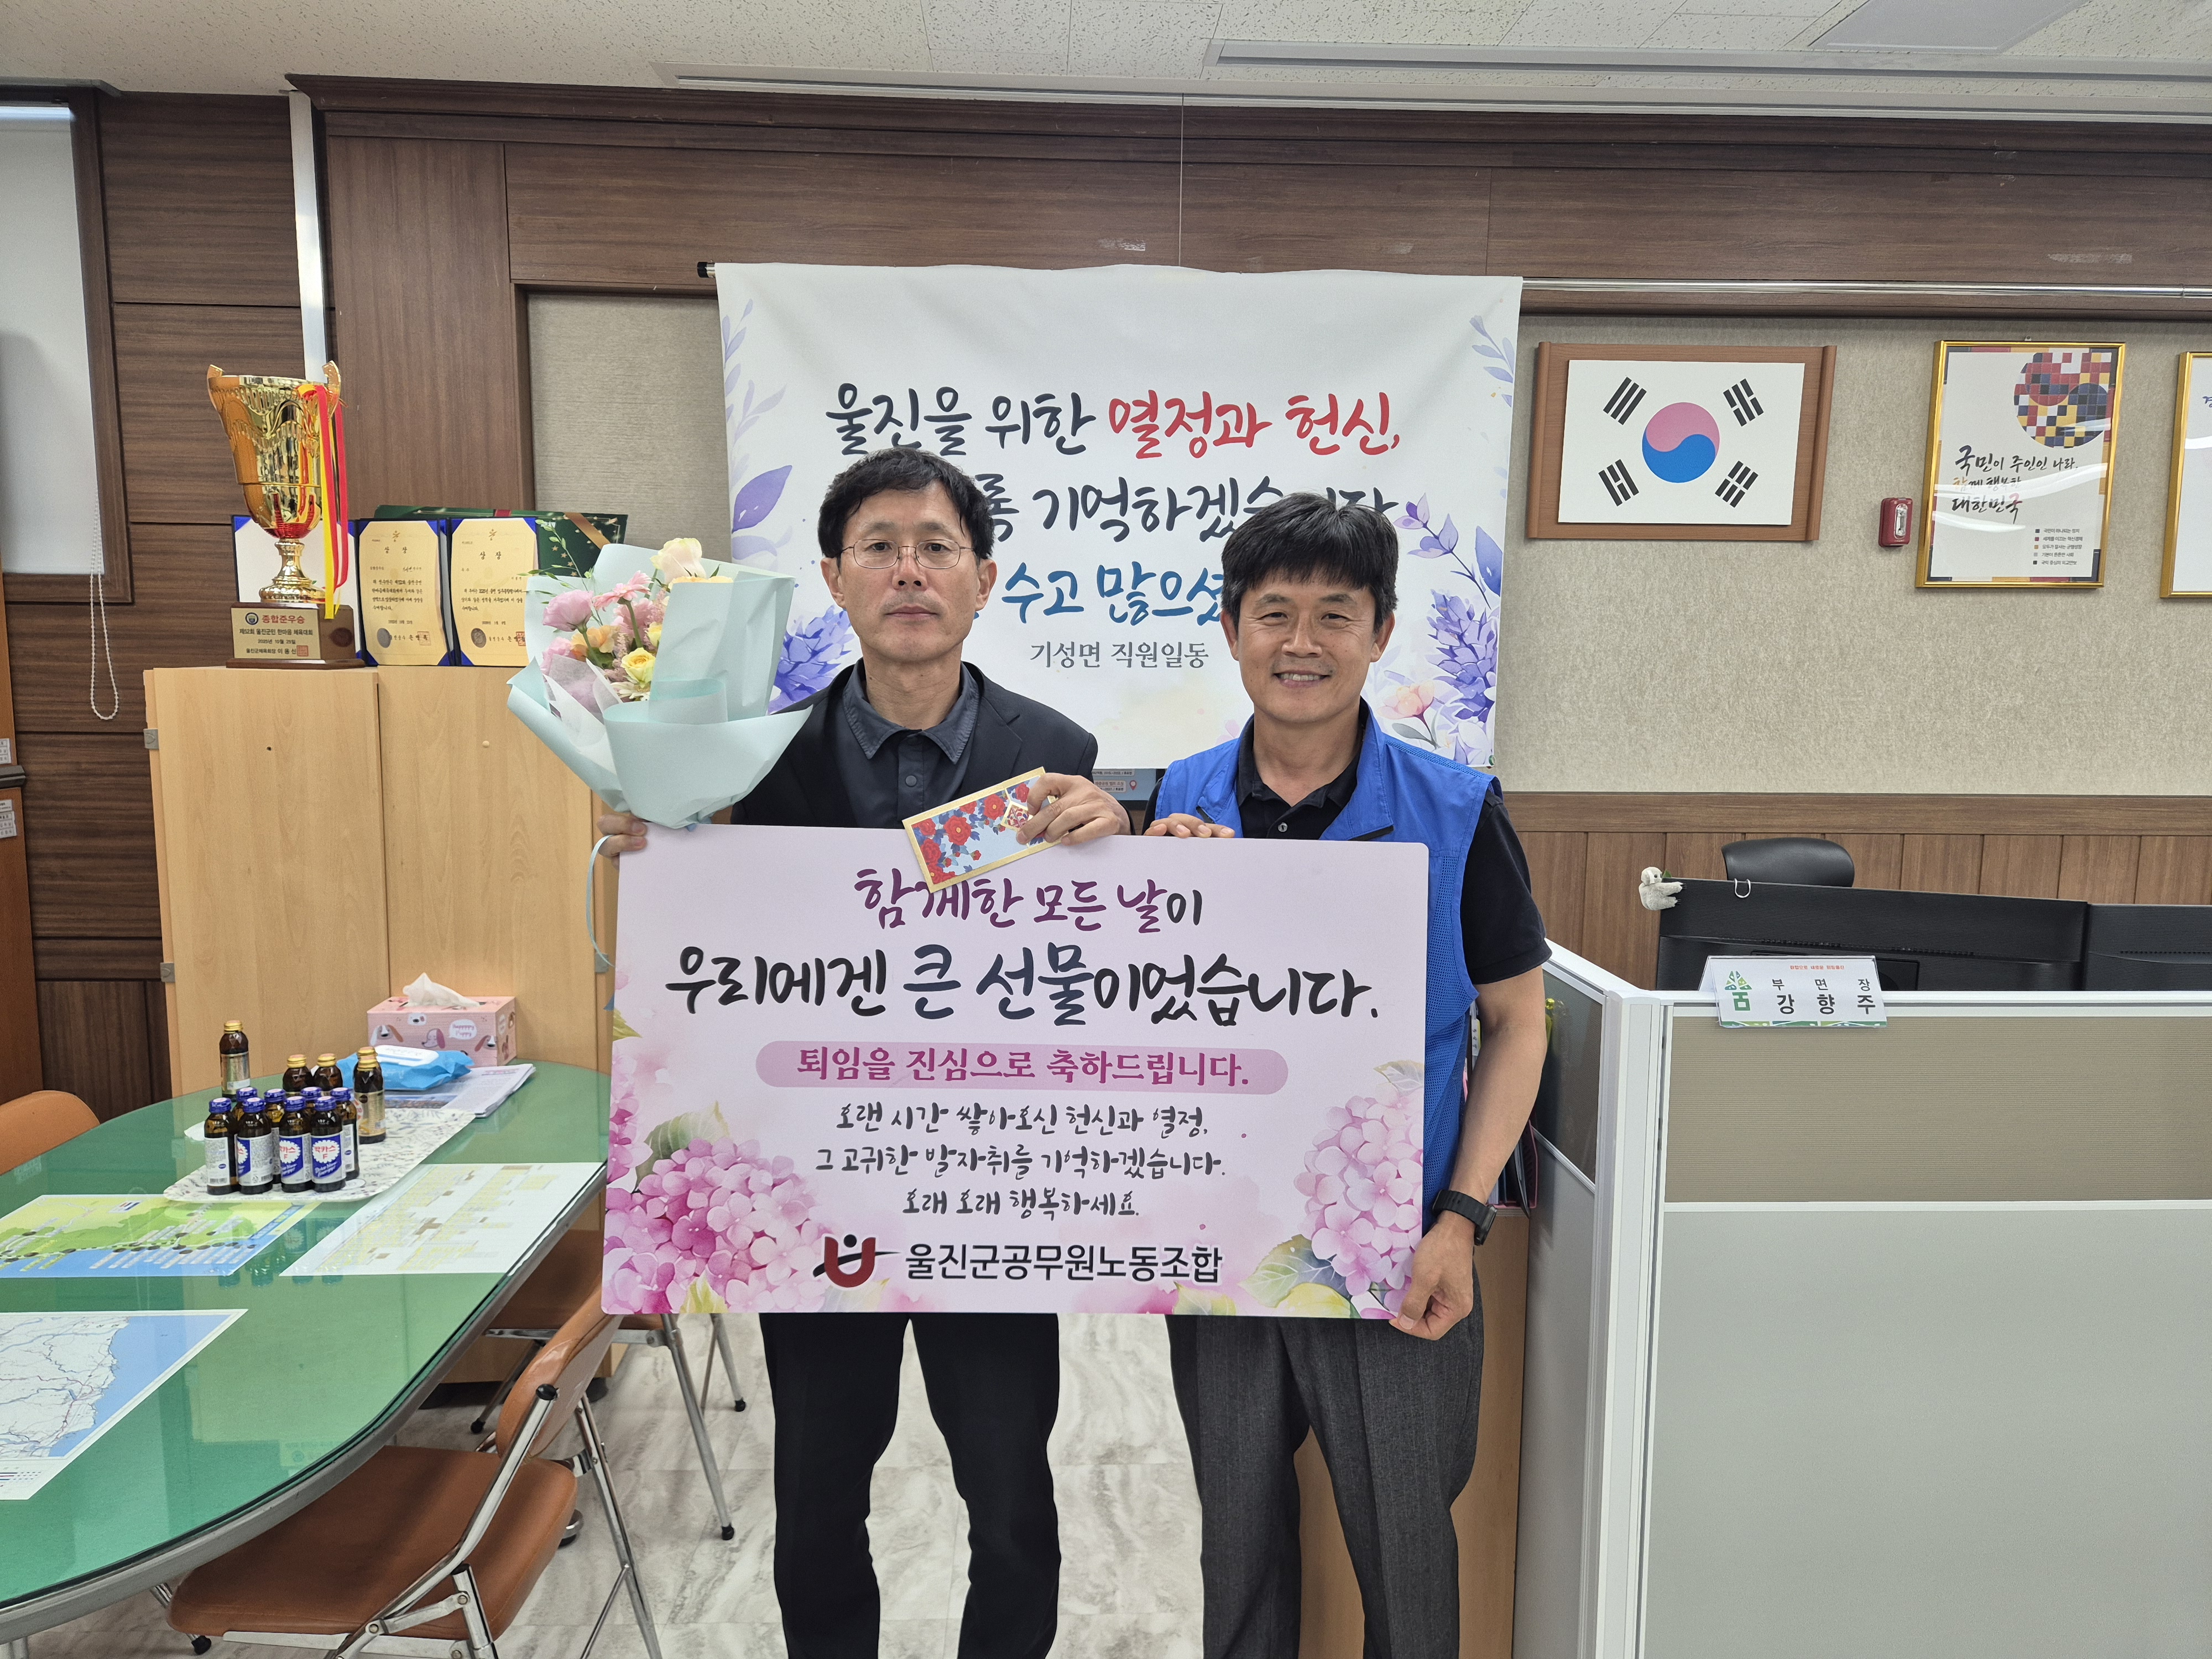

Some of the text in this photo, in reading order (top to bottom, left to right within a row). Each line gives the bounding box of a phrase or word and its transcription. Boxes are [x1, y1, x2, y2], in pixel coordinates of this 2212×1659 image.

[826, 383, 1400, 459] 울진을 위한 열정과 헌신,
[1955, 445, 2079, 477] 국민이 주인인 나라.
[1952, 492, 2023, 525] 대한민국
[1001, 562, 1084, 624] 수고
[262, 615, 305, 624] 종합준우승
[1030, 641, 1209, 669] 기성면 직원일동
[854, 868, 1202, 933] 함께한 모든 날이
[665, 942, 1379, 1026] 우리에겐 큰 선물이었습니다.
[797, 1046, 1249, 1087] 퇴임을 진심으로 축하드립니다.
[836, 1101, 1208, 1140] 오랜 시간 쌓아오신 헌신과 열정,
[815, 1144, 1226, 1181] 그 고귀한 발자취를 기억하겠습니다.
[902, 1187, 1140, 1222] 오래 오래 행복하세요.
[905, 1244, 1224, 1284] 울진군공무원노동조합
